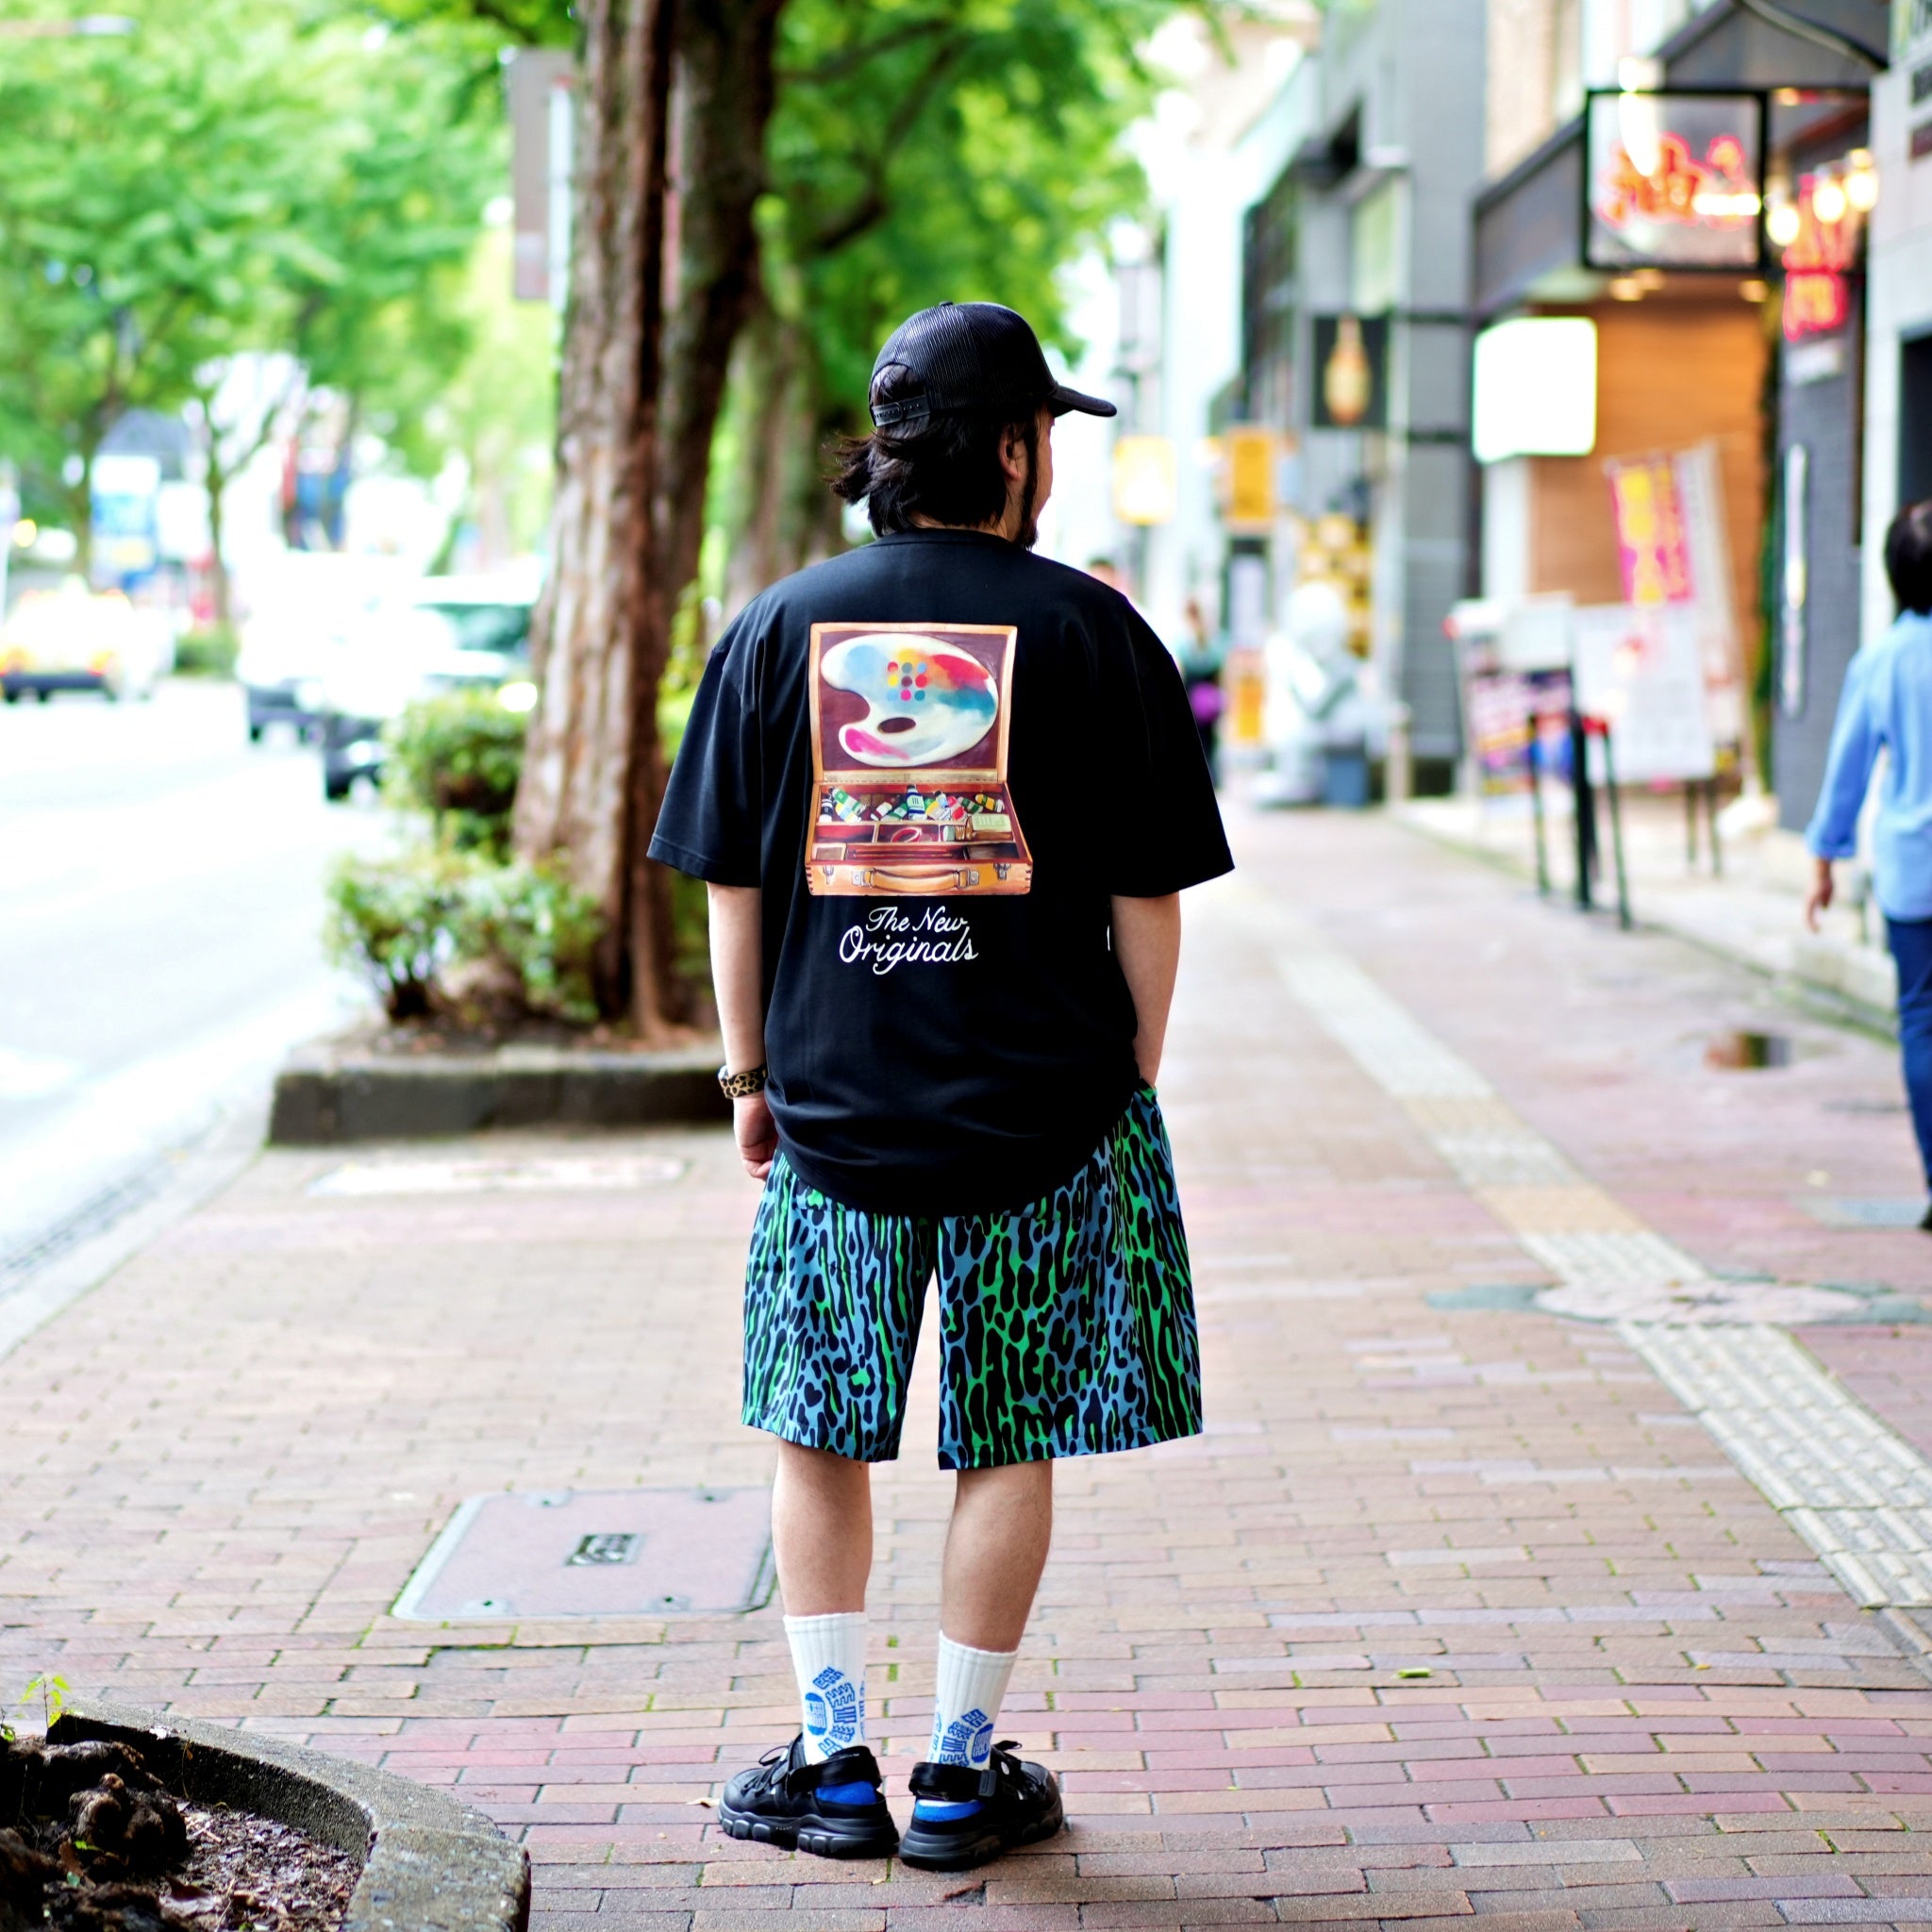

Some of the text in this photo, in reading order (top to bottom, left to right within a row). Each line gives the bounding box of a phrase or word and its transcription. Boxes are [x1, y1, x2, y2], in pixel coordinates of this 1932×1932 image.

[866, 906, 969, 932] The New
[839, 925, 979, 975] Originals
